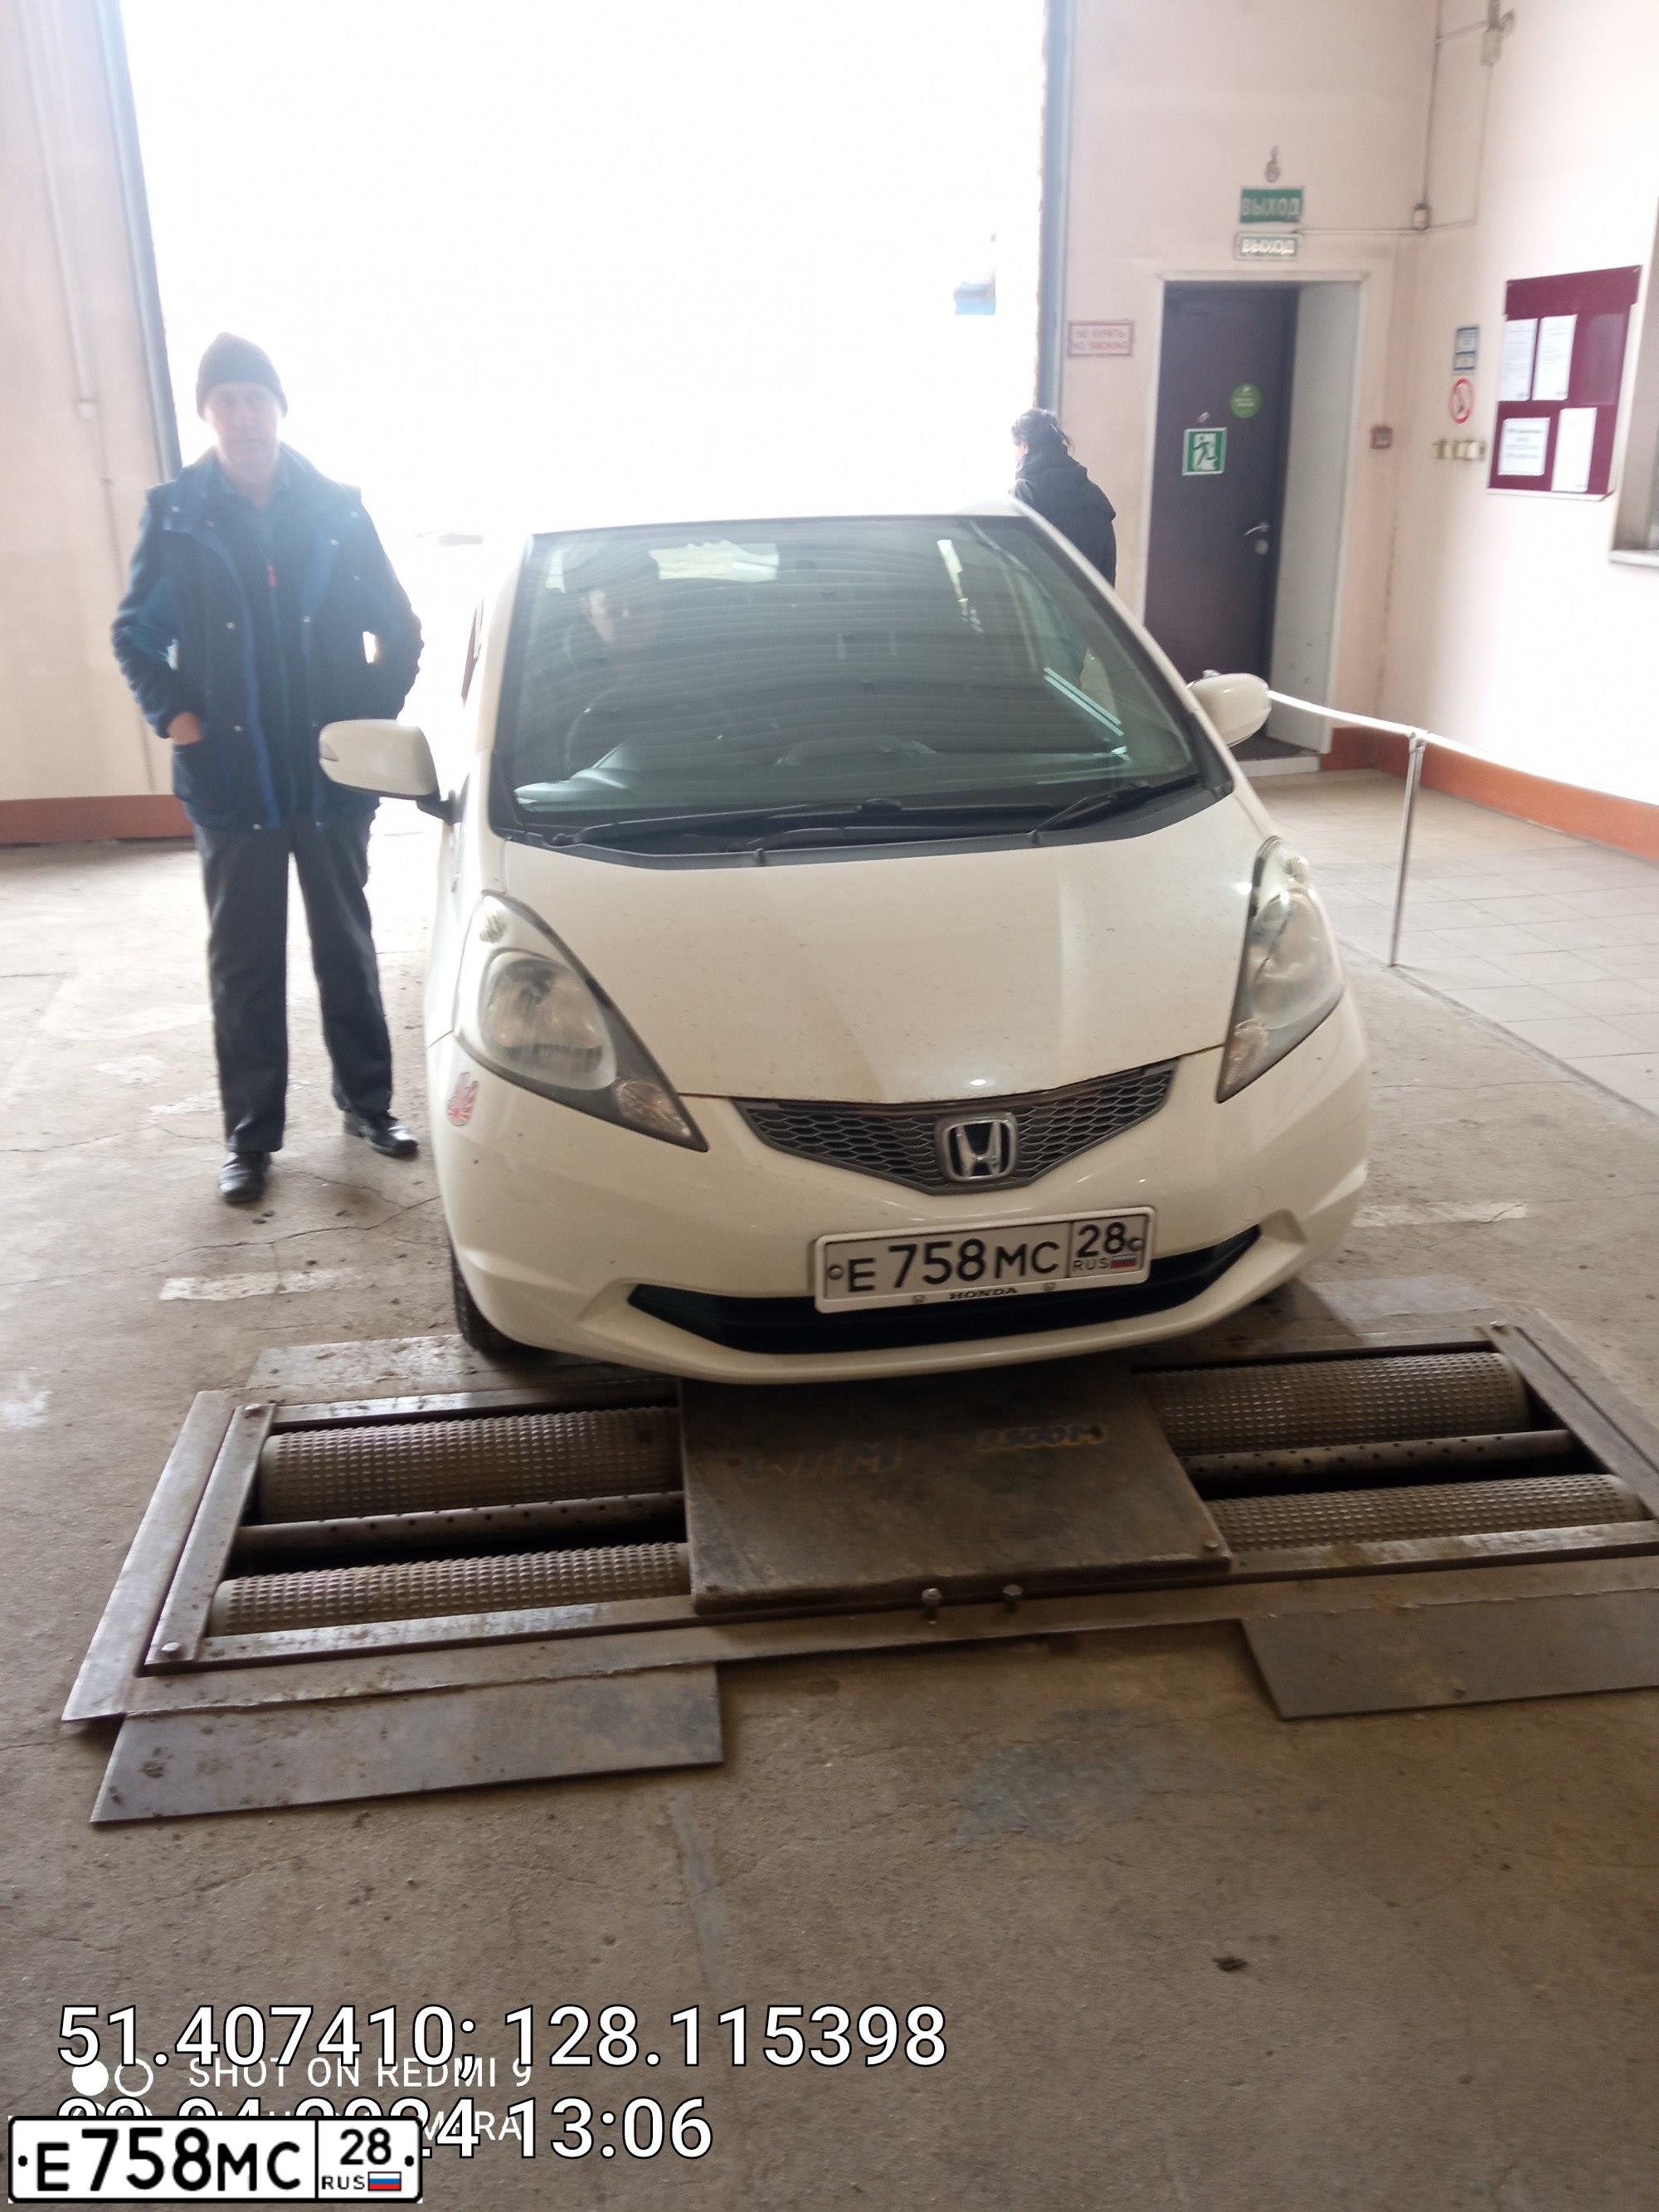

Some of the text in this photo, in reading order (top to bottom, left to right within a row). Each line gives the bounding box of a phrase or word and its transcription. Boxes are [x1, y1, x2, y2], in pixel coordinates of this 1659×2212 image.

[1242, 197, 1301, 218] ВЫХОД
[1077, 1221, 1125, 1258] 28
[1073, 1258, 1108, 1271] RUS
[949, 1287, 1017, 1300] HONDA
